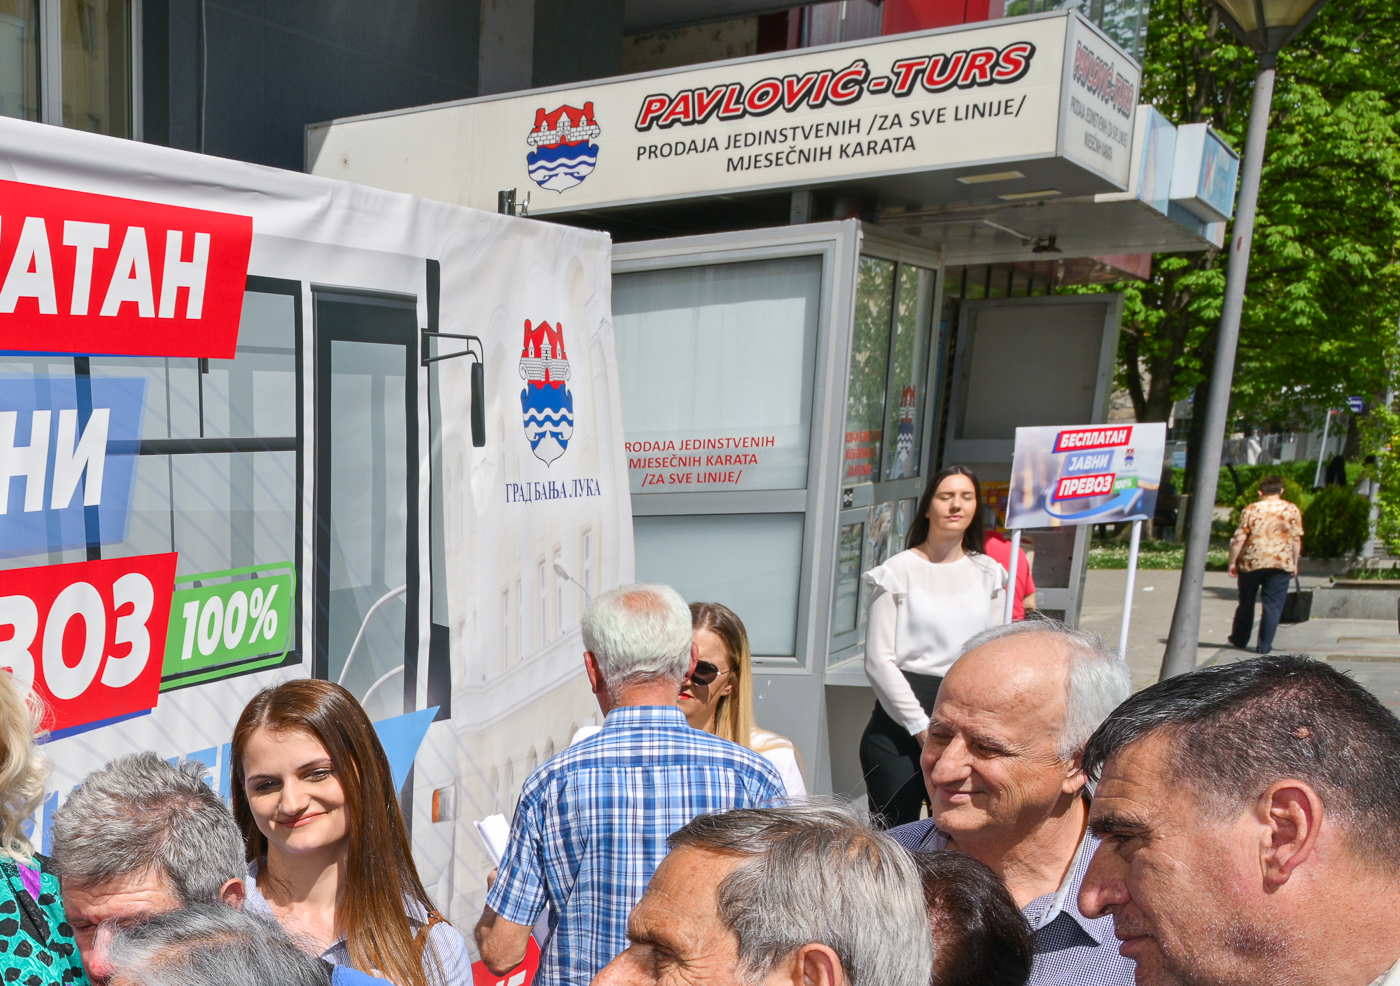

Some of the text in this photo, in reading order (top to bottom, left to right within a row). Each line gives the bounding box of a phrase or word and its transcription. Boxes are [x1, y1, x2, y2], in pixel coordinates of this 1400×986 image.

[636, 95, 1027, 161] PRODAJA JEDINSTVENIH /ZA SVE LINIJE/
[726, 135, 916, 172] MJESEČNIH KARATA
[624, 436, 775, 453] RODAJA JEDINSTVENIH
[1060, 429, 1128, 448] БЕСПЛАТАН
[629, 453, 758, 469] MJESEČNIH KARATA
[1068, 454, 1110, 471] ЈАВНИ
[642, 470, 742, 487] /ZA SVE LINIJE/
[1058, 475, 1132, 497] ПРЕВОЗ 100%
[505, 478, 601, 505] ГРАД БАЊА ЛУКА
[181, 584, 279, 660] 100%
